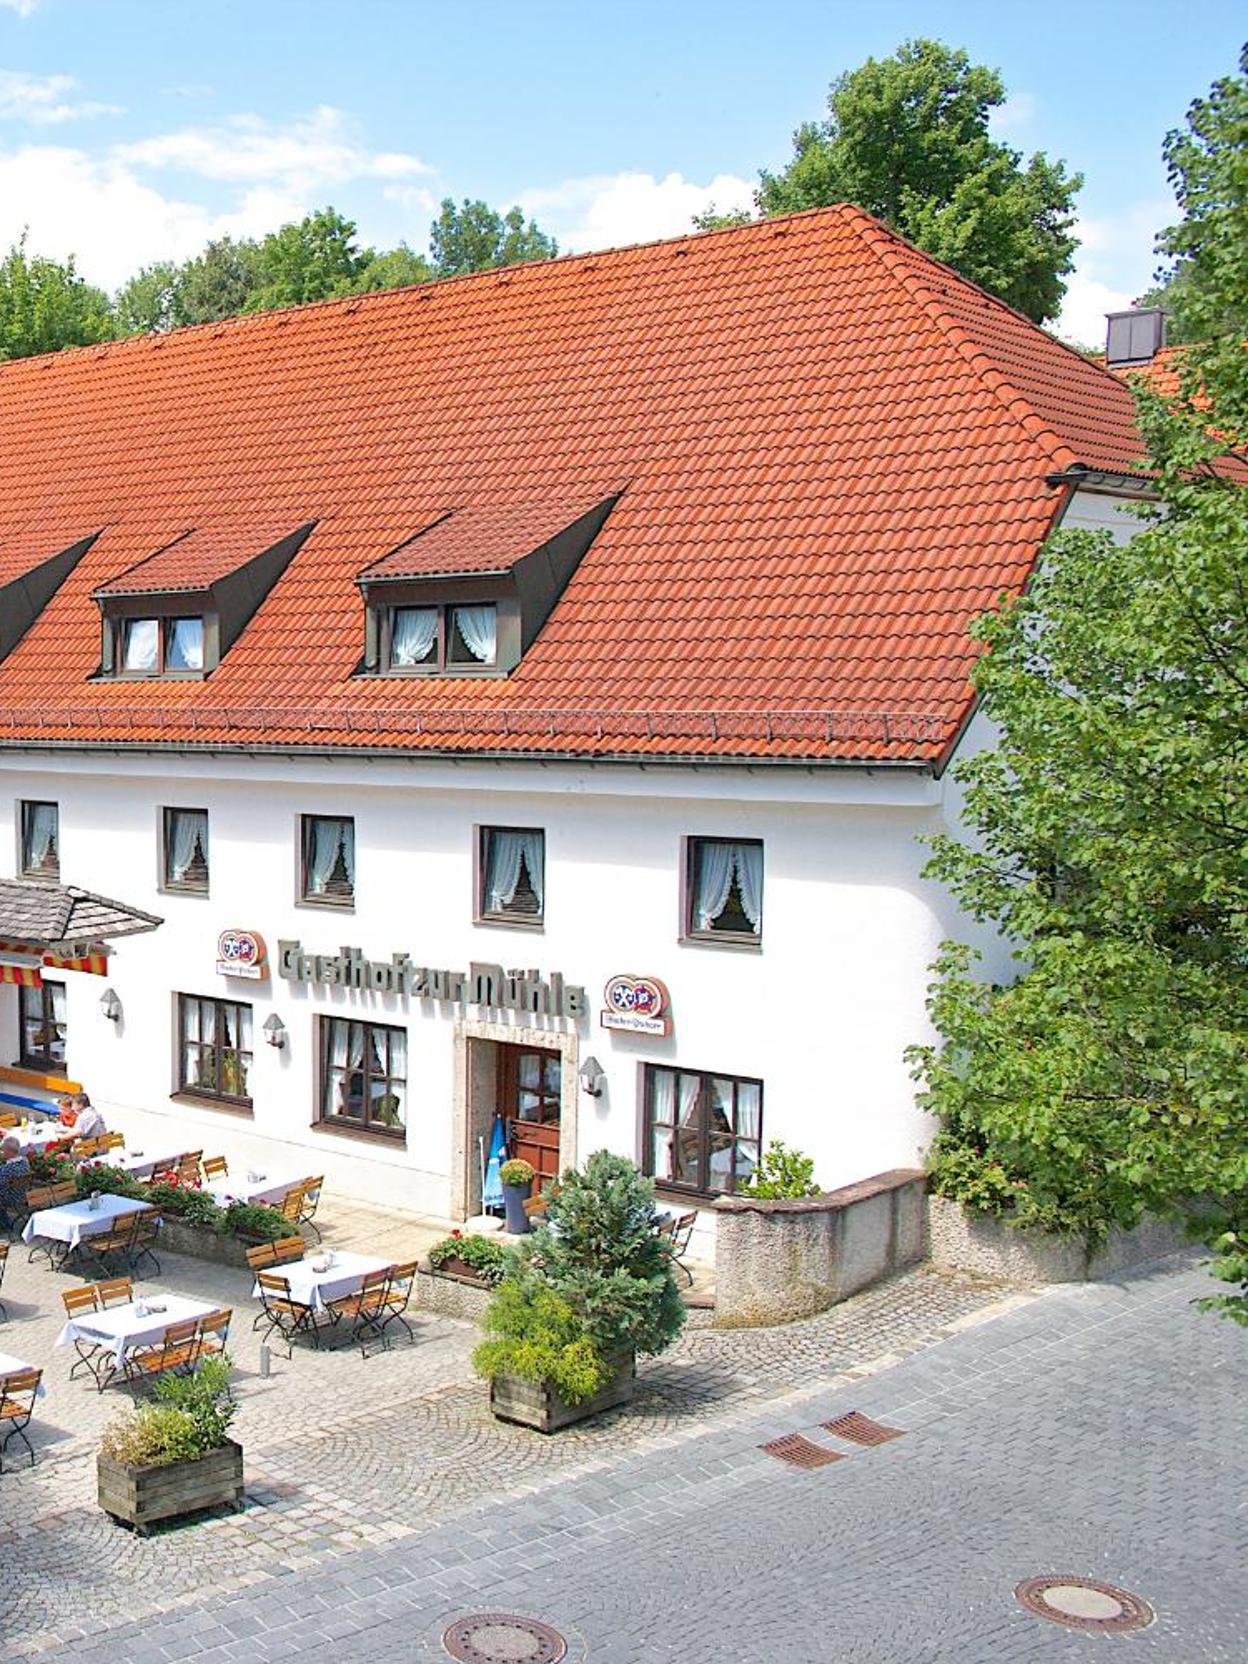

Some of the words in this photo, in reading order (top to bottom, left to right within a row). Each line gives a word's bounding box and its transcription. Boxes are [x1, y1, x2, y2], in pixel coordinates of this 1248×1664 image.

[278, 939, 409, 994] Gasthof
[409, 967, 466, 1001] zur
[468, 961, 585, 1018] Mühle
